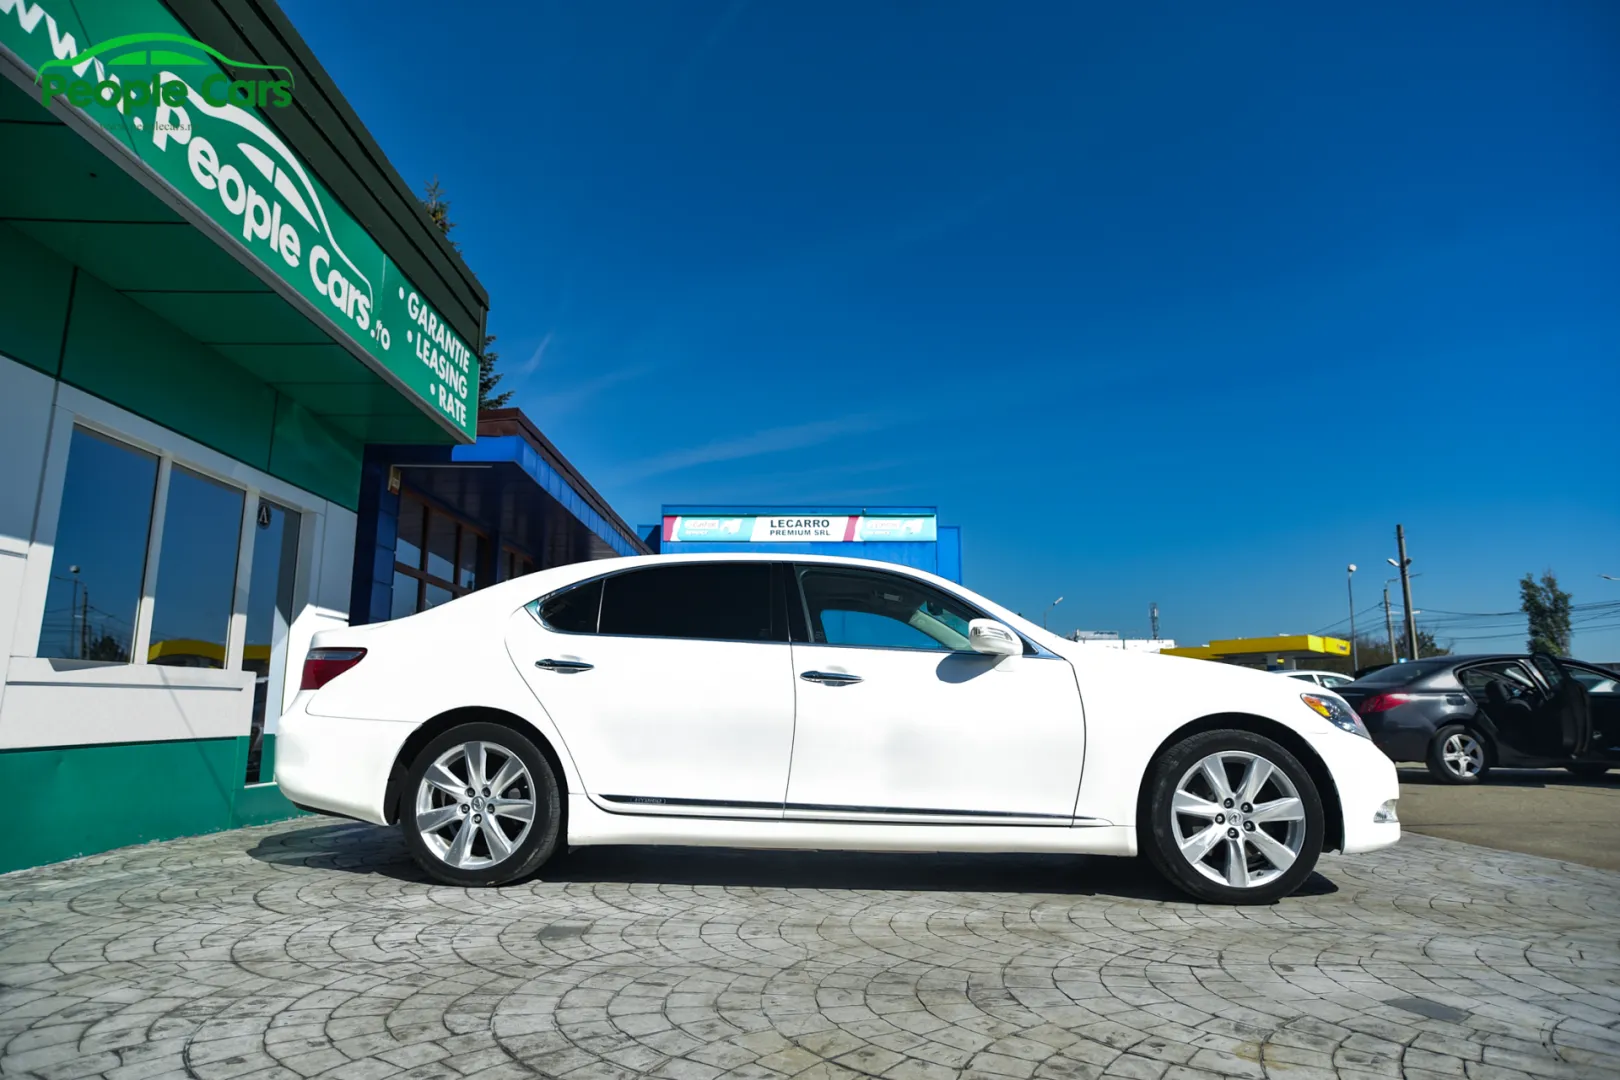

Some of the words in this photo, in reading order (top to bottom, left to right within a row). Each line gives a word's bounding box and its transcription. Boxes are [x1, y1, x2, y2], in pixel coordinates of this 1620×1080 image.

[407, 292, 470, 374] GARANTIE
[416, 332, 468, 399] LEASING
[438, 384, 467, 427] RATE
[770, 519, 830, 528] LECARRO
